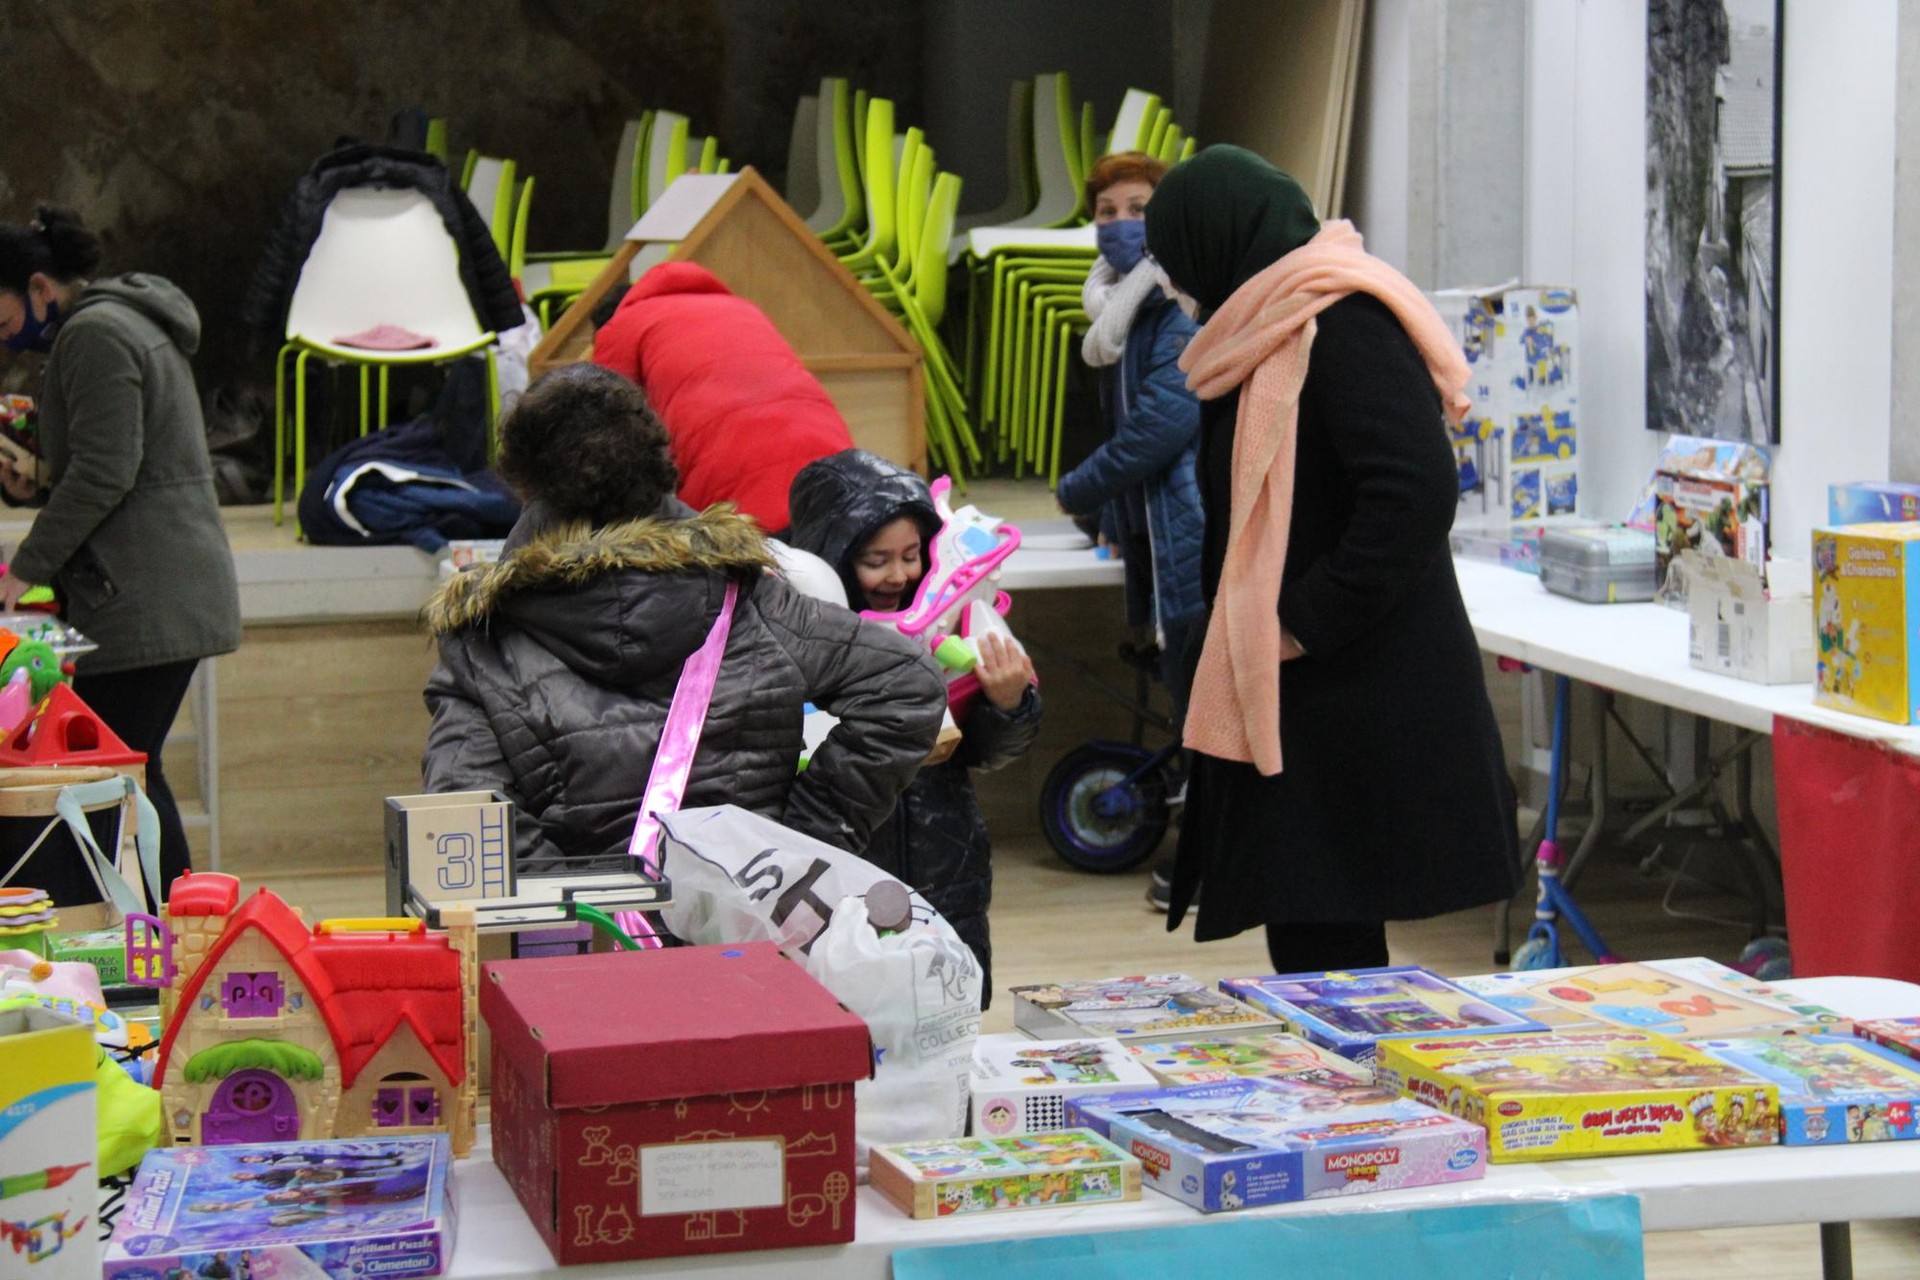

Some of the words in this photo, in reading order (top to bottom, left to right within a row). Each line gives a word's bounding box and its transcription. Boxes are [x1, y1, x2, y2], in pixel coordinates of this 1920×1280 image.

[437, 832, 475, 890] 3
[1327, 1150, 1397, 1171] MONOPOLY
[367, 1255, 431, 1272] Clementoni
